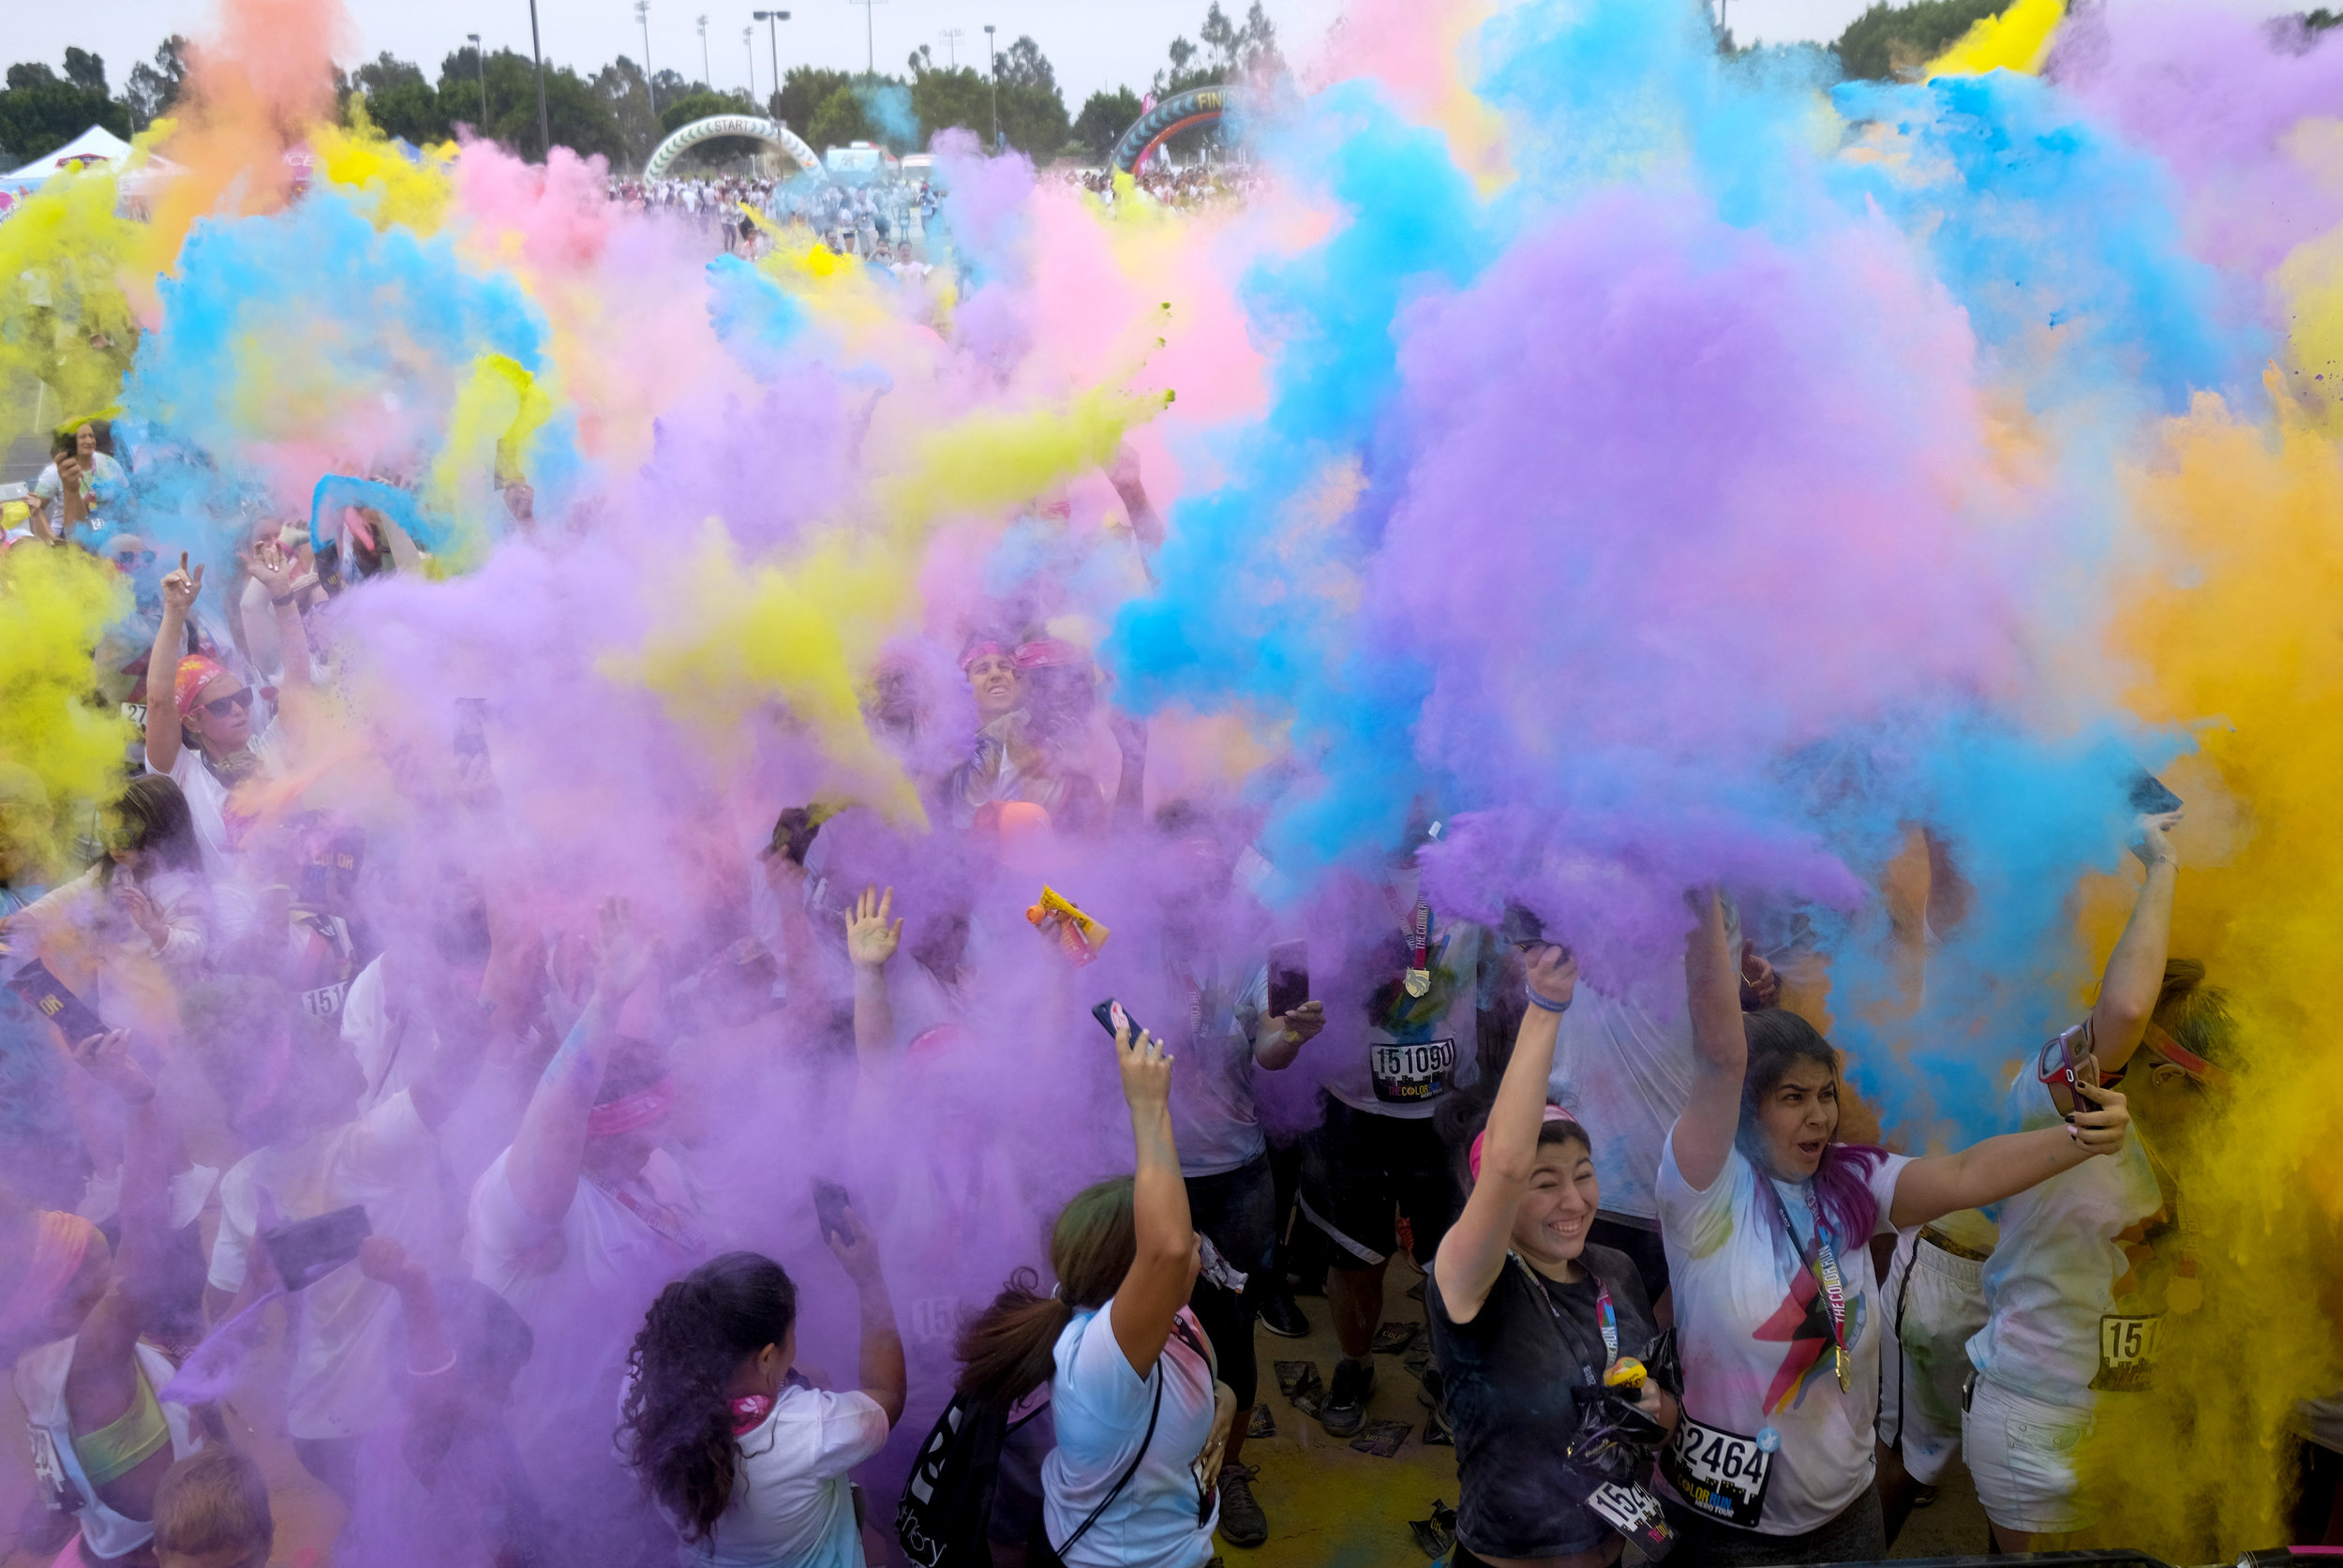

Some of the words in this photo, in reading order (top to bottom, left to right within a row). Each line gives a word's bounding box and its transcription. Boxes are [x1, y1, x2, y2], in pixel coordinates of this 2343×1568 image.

[714, 119, 748, 132] START
[1417, 909, 1427, 934] COLOR
[1416, 934, 1425, 949] THE
[1378, 1043, 1452, 1075] 151090
[1389, 1087, 1401, 1097] THE
[1402, 1085, 1428, 1097] COLOR
[1819, 1245, 1834, 1268] RUN
[1824, 1265, 1843, 1302] COLOR
[1832, 1301, 1845, 1323] THE
[1601, 1326, 1618, 1350] RUN
[1678, 1472, 1709, 1503] COLOR
[1709, 1491, 1733, 1510] RUN
[1714, 1505, 1735, 1518] TOUR
